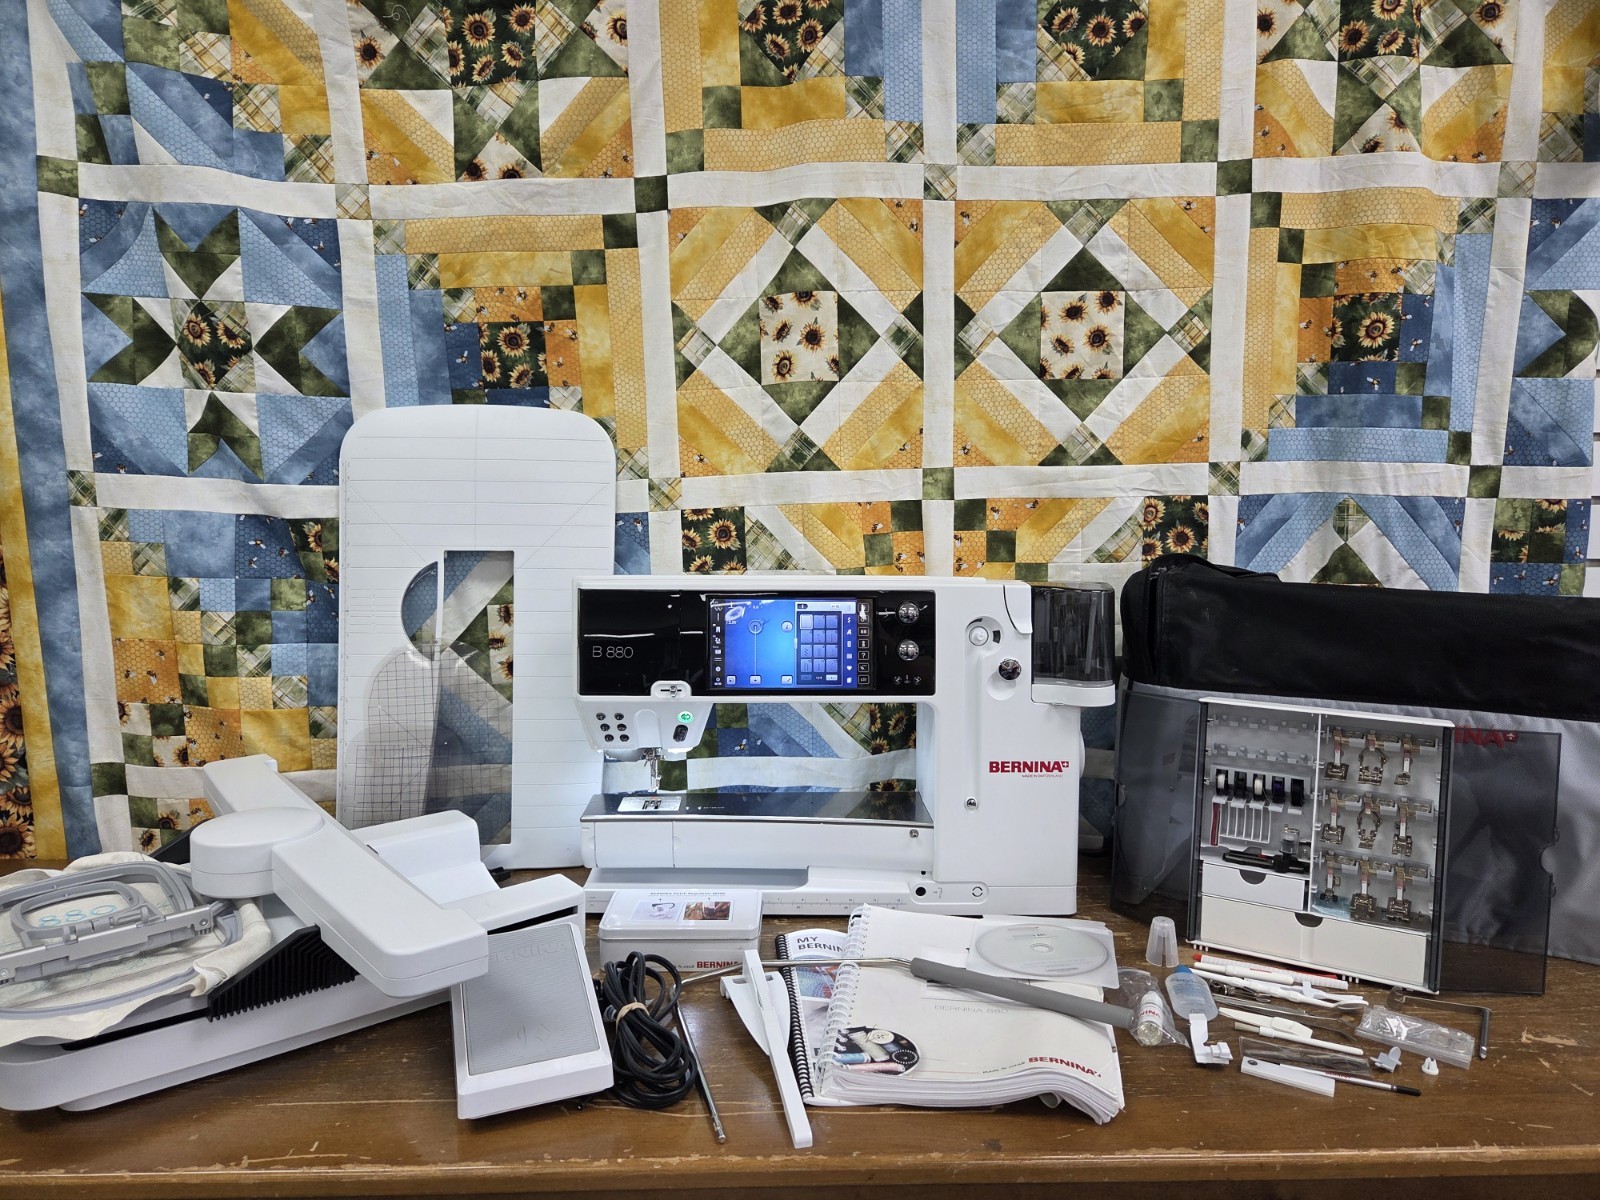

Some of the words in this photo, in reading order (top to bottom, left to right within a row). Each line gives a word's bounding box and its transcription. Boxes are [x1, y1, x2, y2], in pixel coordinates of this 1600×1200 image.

[592, 646, 602, 659] B
[606, 646, 634, 659] 880
[989, 761, 1064, 773] BERNINA
[39, 904, 117, 928] 880
[797, 936, 818, 944] MY
[696, 961, 738, 969] BERNIN
[934, 1004, 983, 1013] BERNINA
[1028, 1056, 1096, 1077] BERNINA
